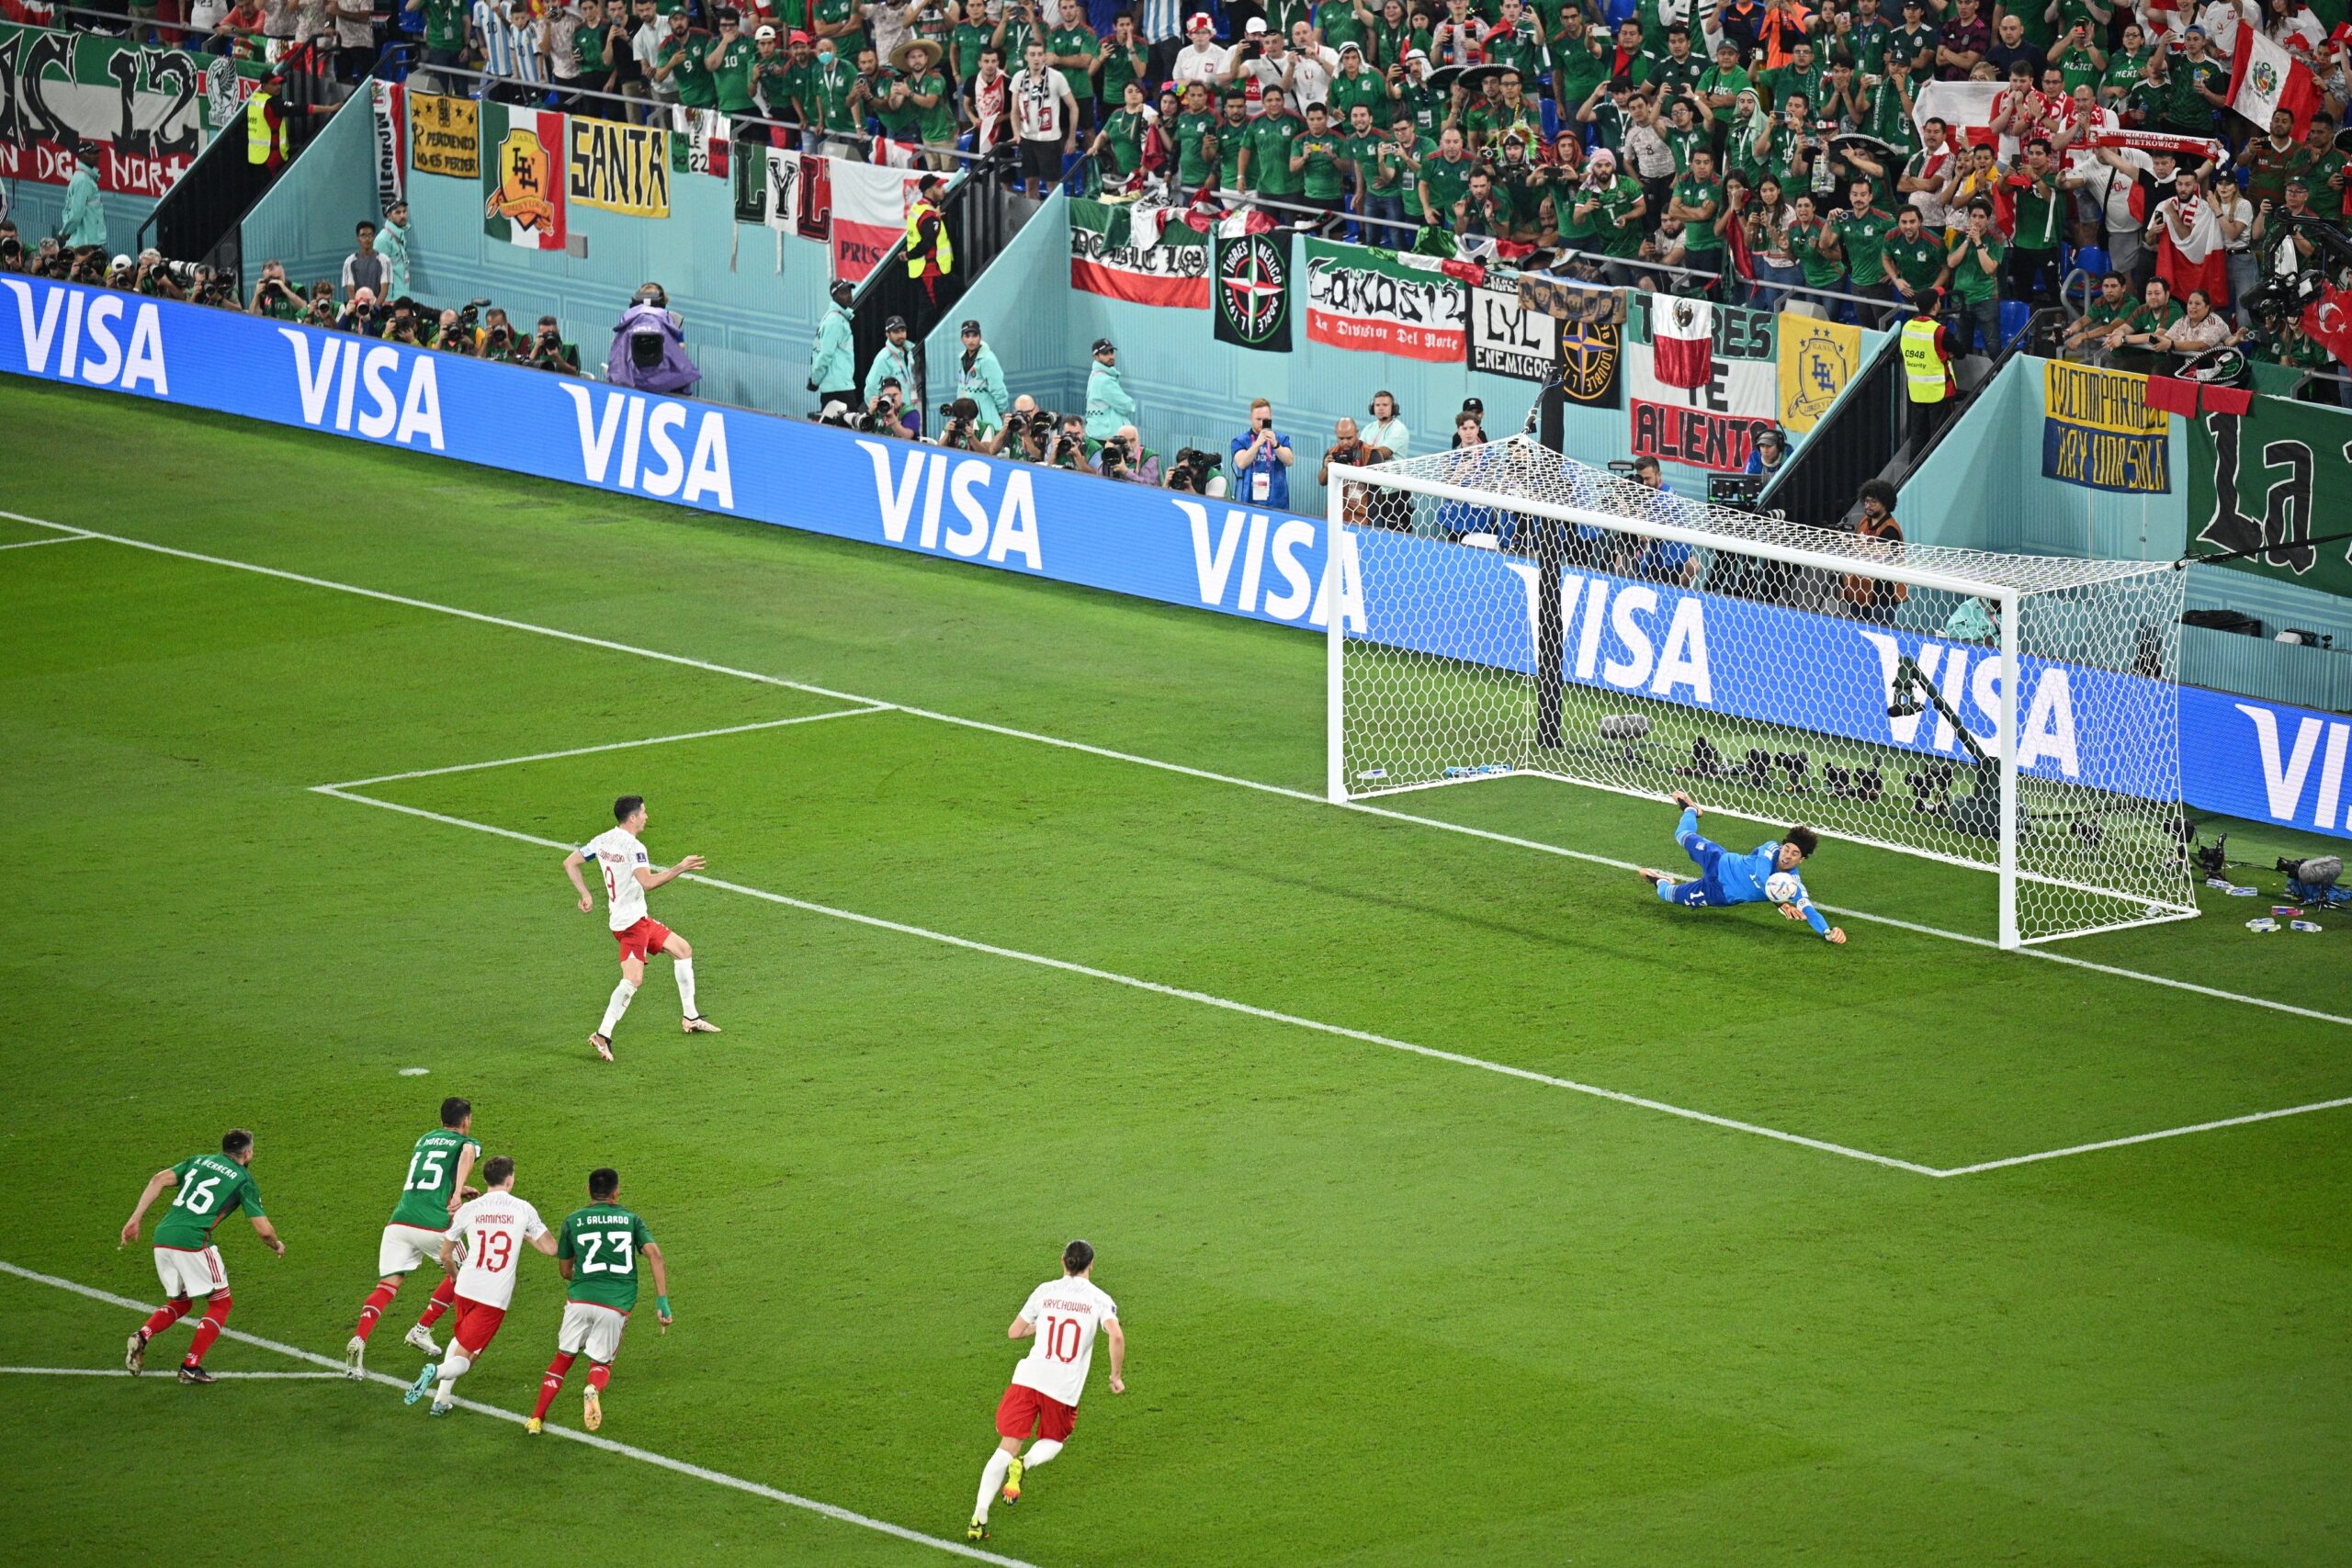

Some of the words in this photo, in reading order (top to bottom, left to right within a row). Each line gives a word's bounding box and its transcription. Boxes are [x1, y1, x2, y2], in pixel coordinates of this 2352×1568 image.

[684, 60, 693, 73] 9
[724, 55, 739, 68] 10
[571, 119, 670, 209] SANTA
[2125, 138, 2179, 149] NIETKOWICE
[108, 146, 192, 195] NORT
[840, 241, 889, 265] PRUS
[1223, 241, 1249, 274] TIGRES
[1, 279, 168, 395] VISA
[1484, 298, 1541, 351] LYL
[1634, 293, 1772, 358] TRES
[1475, 346, 1551, 378] ENEMIGOS
[278, 328, 445, 450] VISA
[2050, 364, 2166, 430] INCOMPARAB
[559, 382, 734, 510] VISA
[2127, 438, 2165, 491] SOLA
[855, 439, 1043, 570] VISA
[1171, 499, 1368, 636] VISA
[1859, 630, 2080, 778] VISA
[2234, 703, 2352, 832] VI
[605, 865, 617, 903] 9
[424, 1137, 457, 1146] MORENO
[172, 1168, 221, 1215] 16
[201, 1159, 238, 1180] HERRERA
[403, 1150, 448, 1191] 15
[475, 1213, 514, 1224] KAMIŃSKI
[576, 1217, 584, 1227] J.
[586, 1215, 629, 1225] GALLARDO
[476, 1229, 513, 1273] 13
[577, 1231, 633, 1275] 23
[1042, 1298, 1092, 1314] KRYCHOWIAK
[1045, 1315, 1081, 1364] 10
